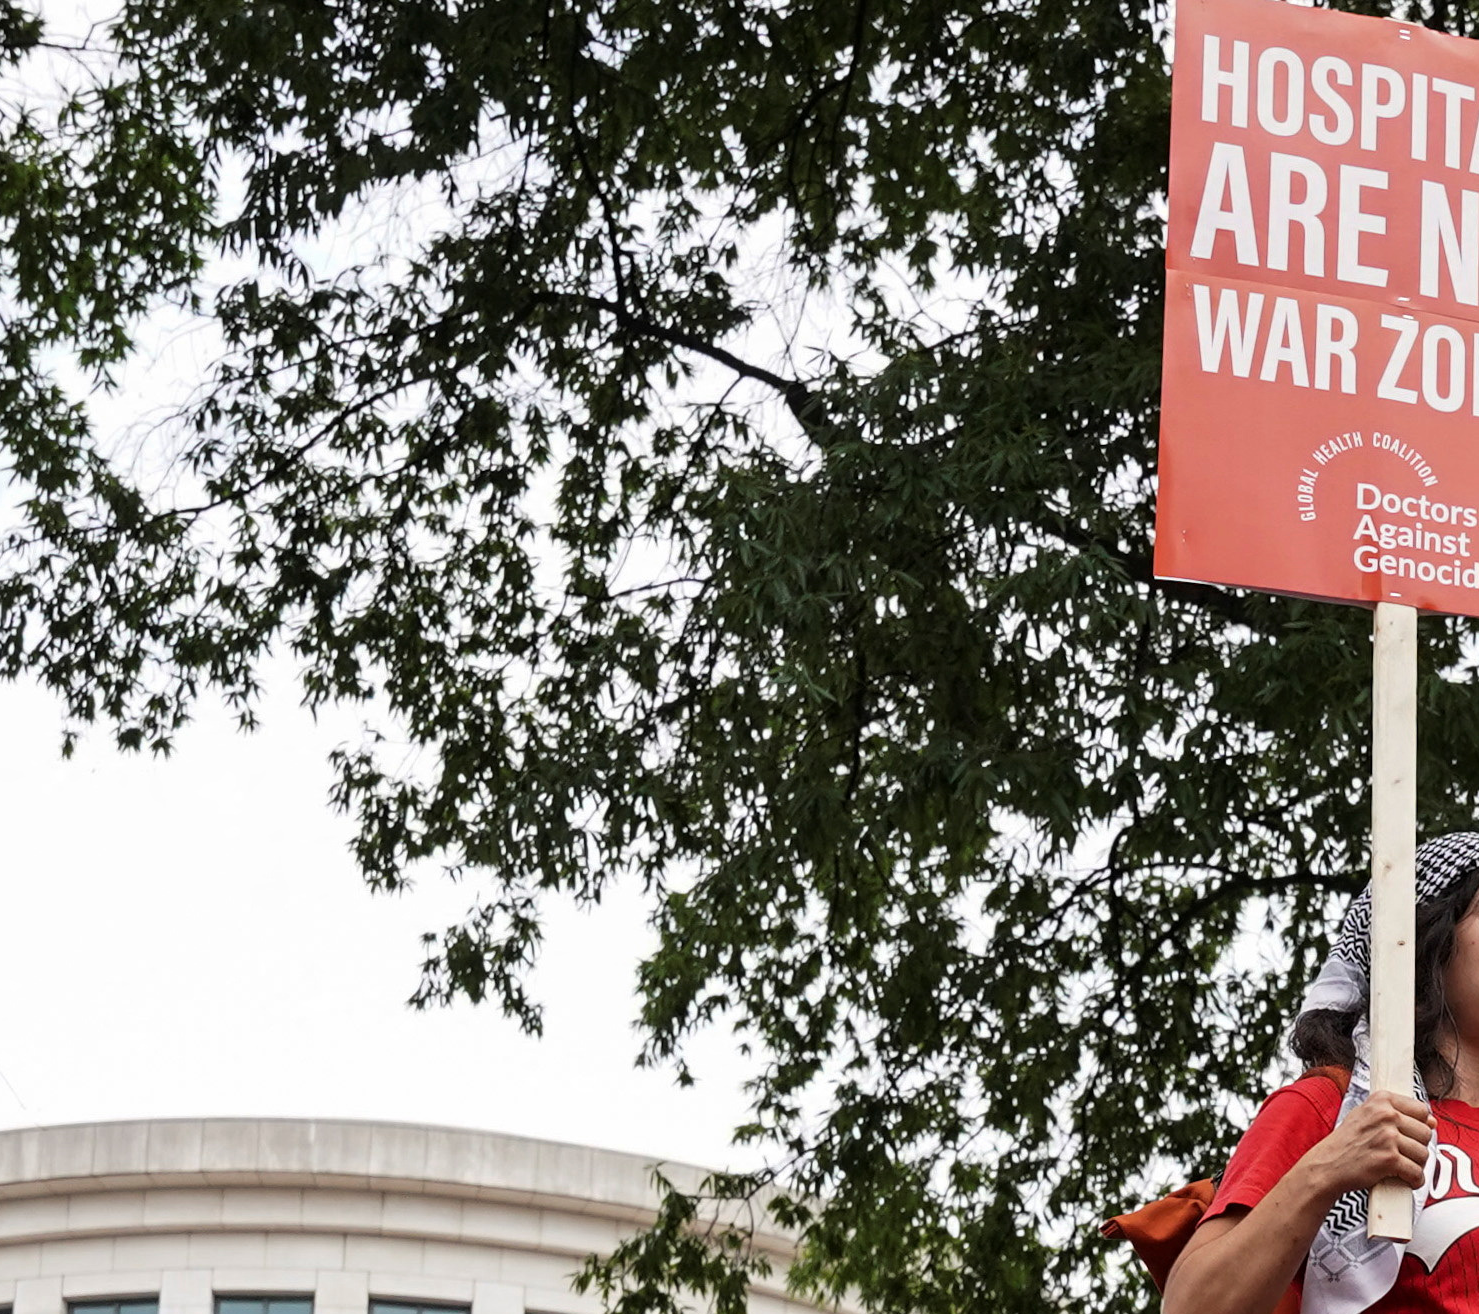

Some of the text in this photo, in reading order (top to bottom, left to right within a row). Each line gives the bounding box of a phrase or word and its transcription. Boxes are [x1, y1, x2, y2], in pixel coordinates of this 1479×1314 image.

[1190, 141, 1389, 288] ARE
[1193, 284, 1360, 394] WAR
[1297, 431, 1439, 521] GLOBAL HEALTH COALITION
[1356, 482, 1478, 528] Doctors
[1353, 514, 1470, 557] Against
